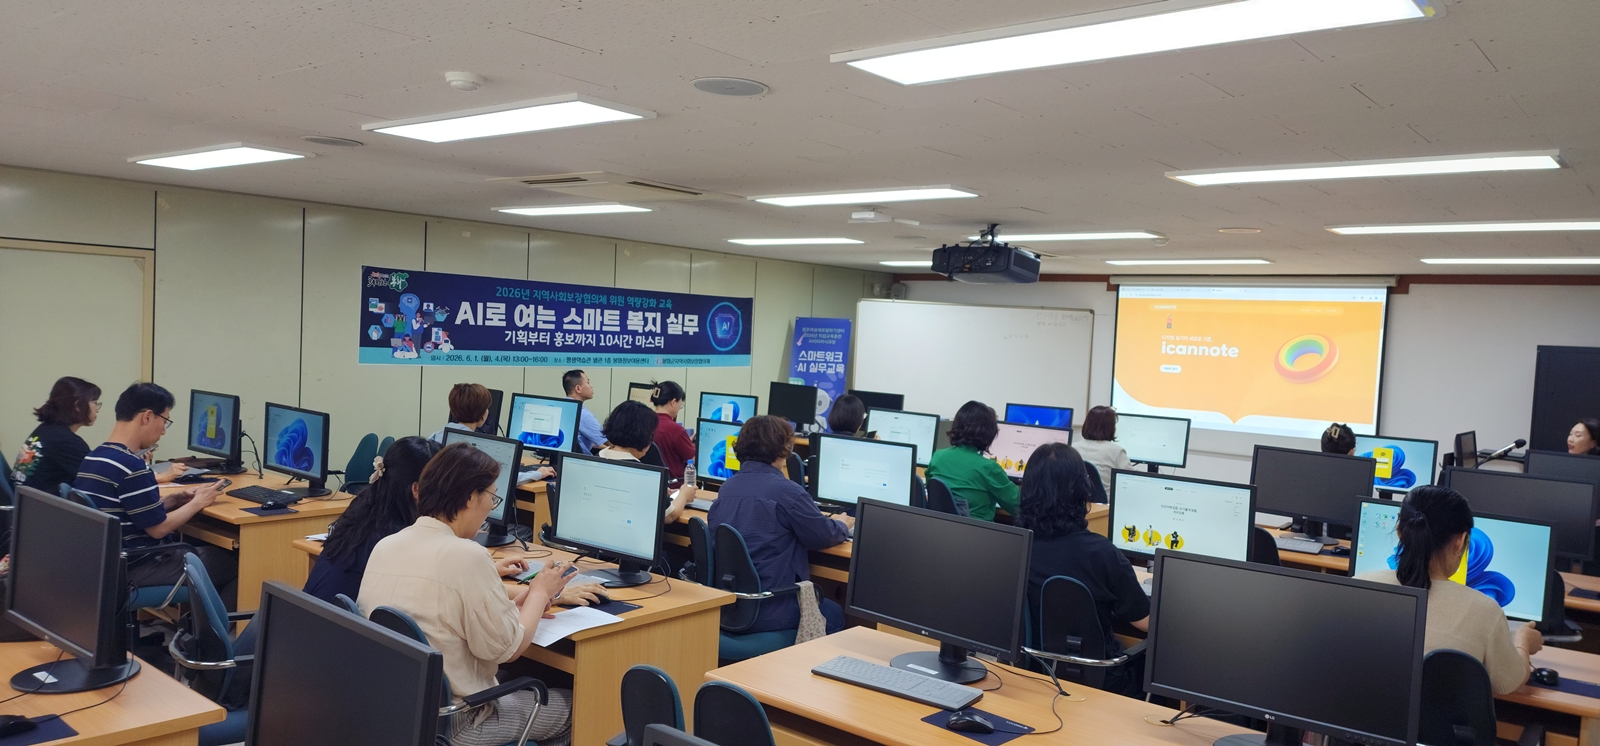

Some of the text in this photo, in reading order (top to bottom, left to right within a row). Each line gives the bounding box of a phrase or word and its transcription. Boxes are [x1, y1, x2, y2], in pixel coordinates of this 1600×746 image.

[495, 286, 673, 310] 2026년 지역사회보장협의체 위원 역량강화 교육
[454, 301, 700, 336] AI로 여는 스마트 복지 실무
[721, 322, 731, 331] AI
[504, 329, 665, 349] 기획부터 홍보까지 10시간 마스터
[798, 350, 843, 363] 스마트워크
[1161, 341, 1240, 358] icannote
[512, 355, 549, 363] 13:00~16:00
[809, 362, 845, 374] 실무교육
